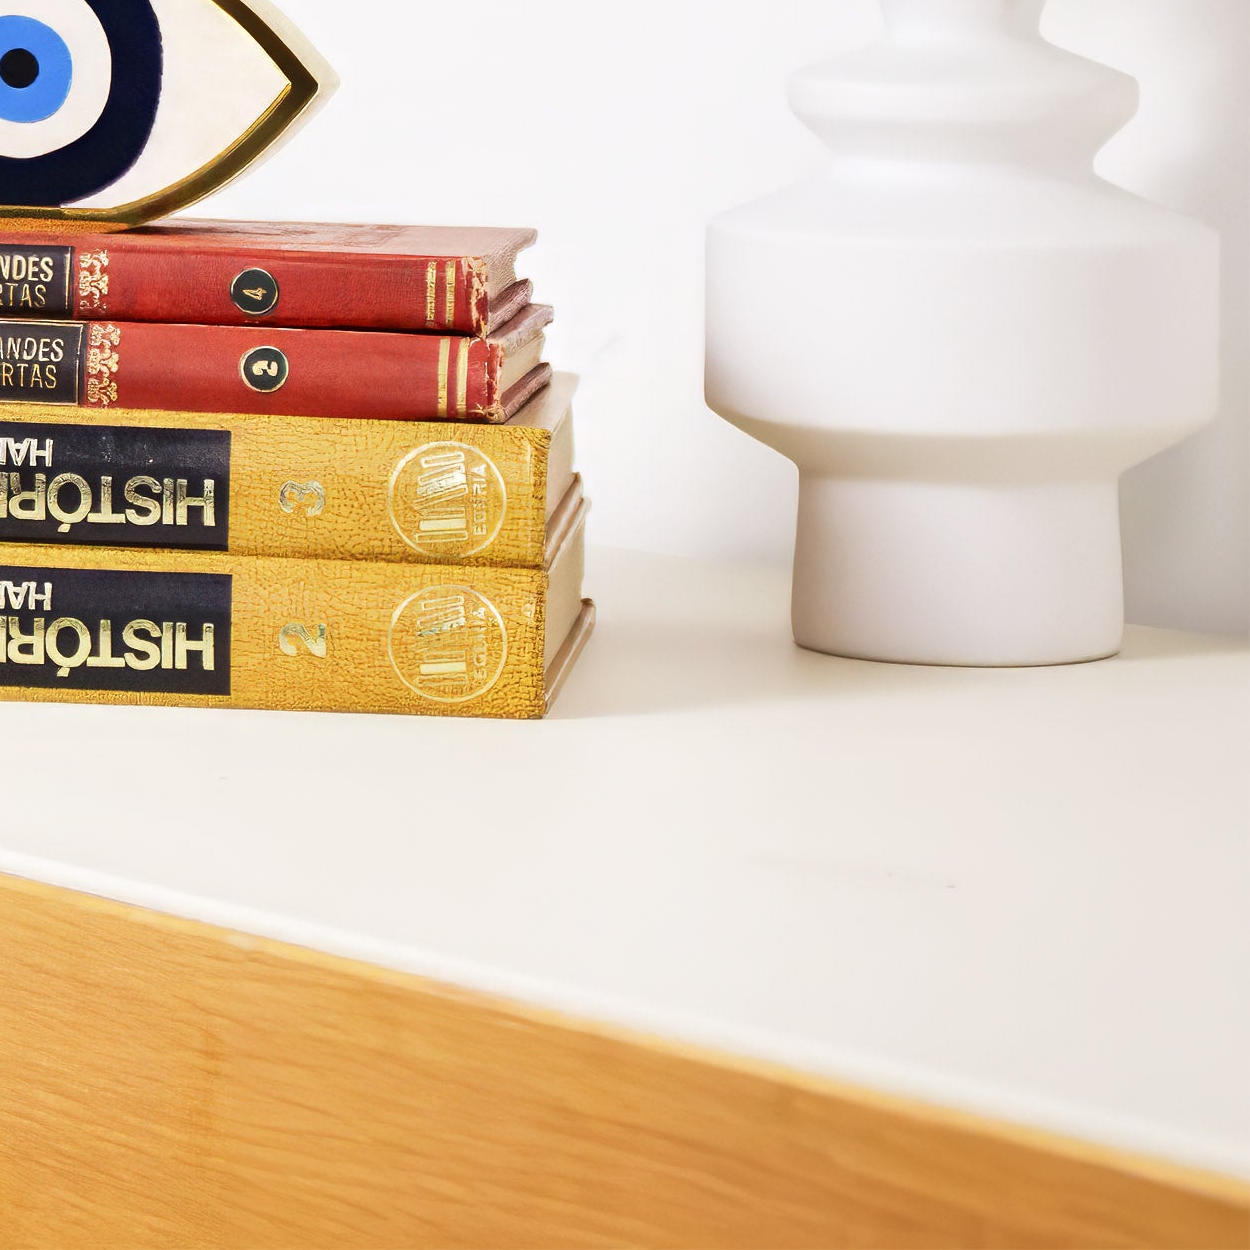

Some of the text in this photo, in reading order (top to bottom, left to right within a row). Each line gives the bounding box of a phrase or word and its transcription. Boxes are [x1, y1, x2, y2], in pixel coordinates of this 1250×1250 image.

[242, 287, 267, 300] 4
[252, 359, 279, 377] 2
[279, 480, 326, 517] 3
[278, 622, 327, 659] 2
